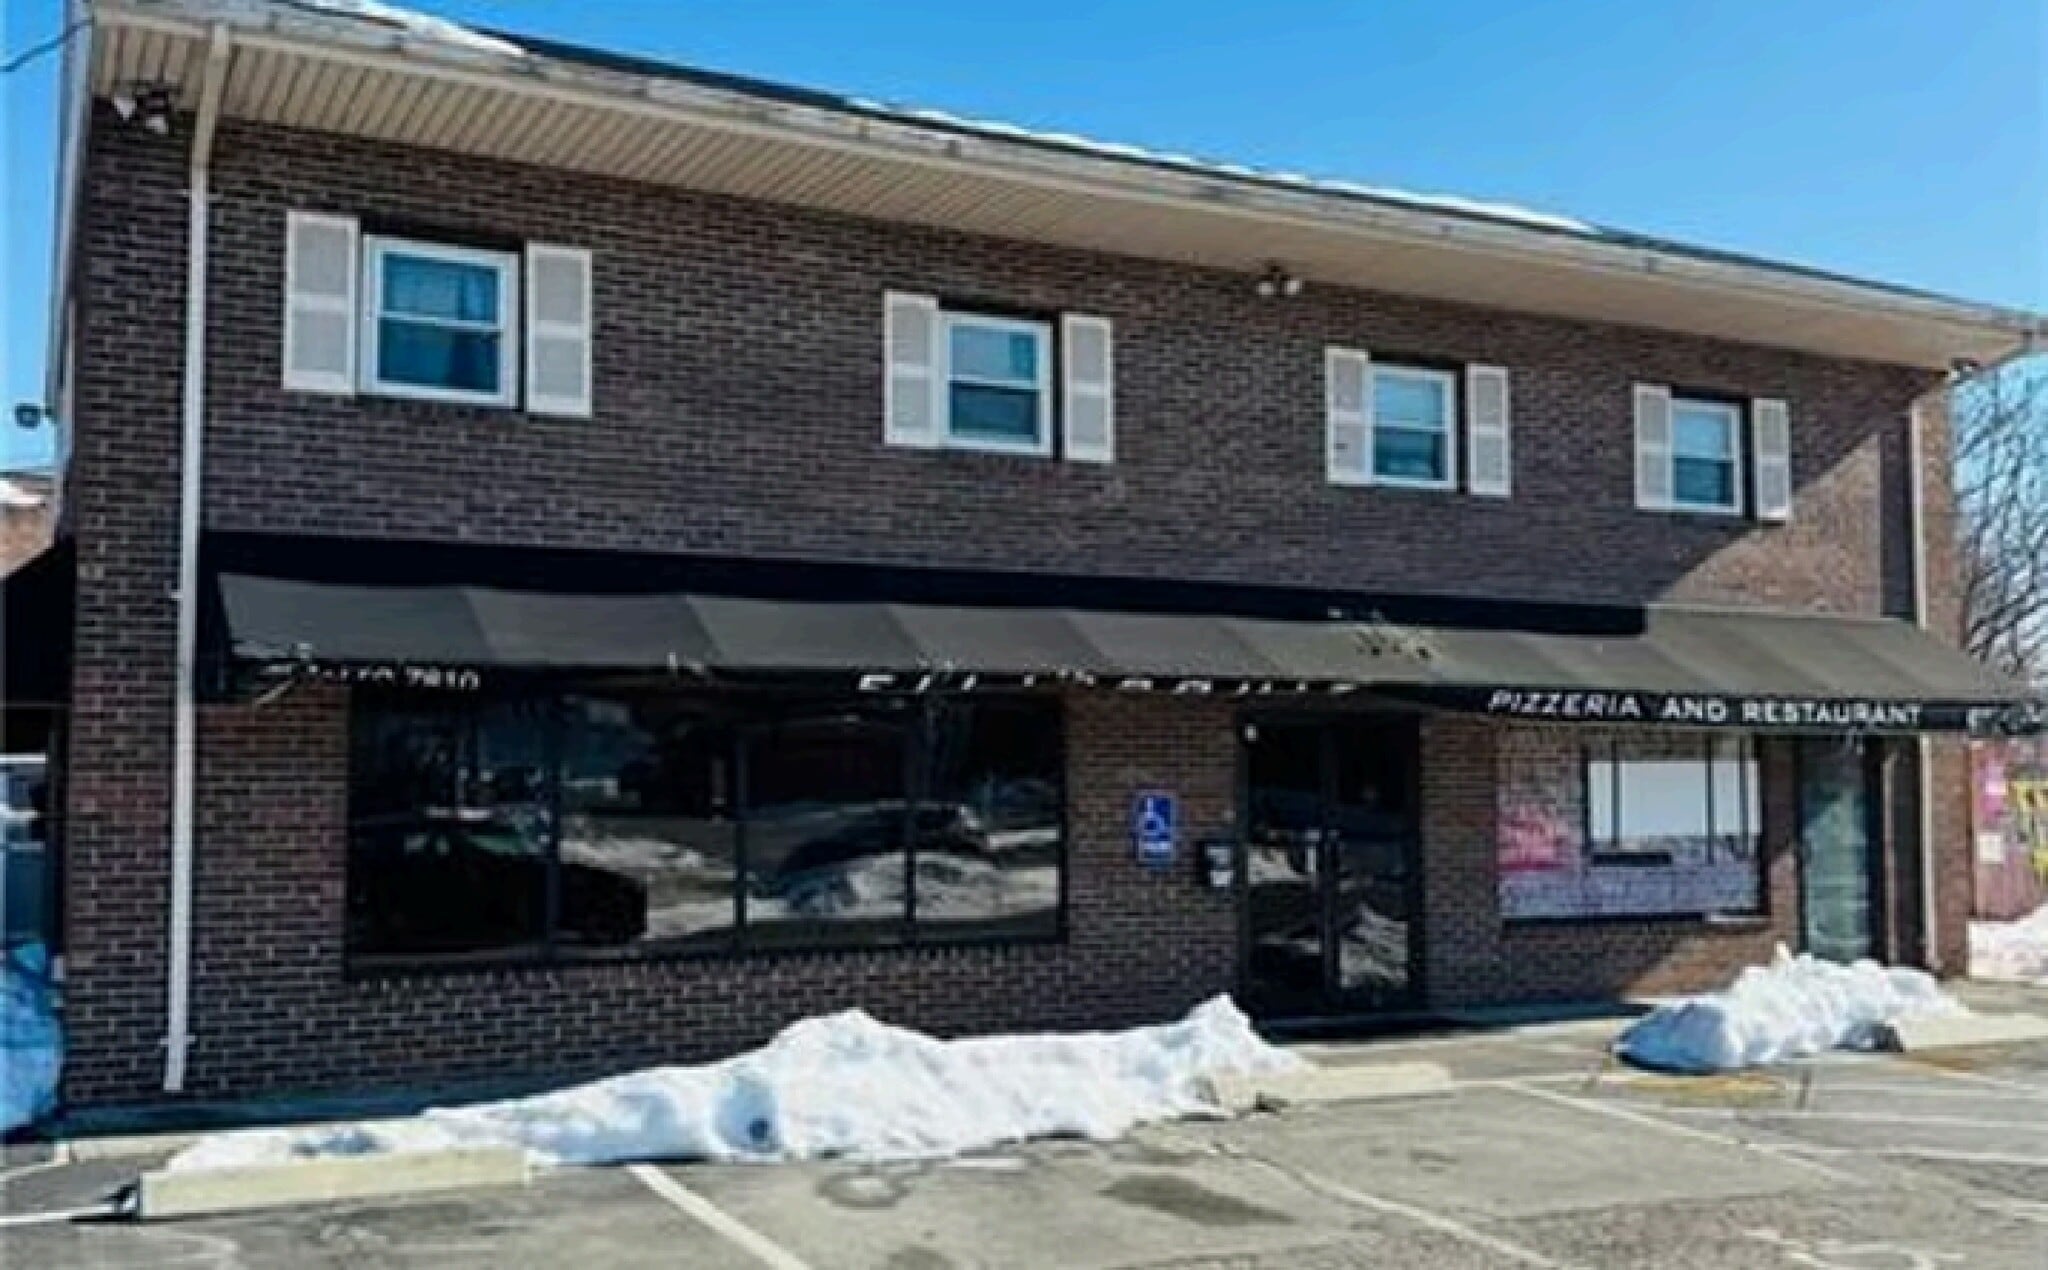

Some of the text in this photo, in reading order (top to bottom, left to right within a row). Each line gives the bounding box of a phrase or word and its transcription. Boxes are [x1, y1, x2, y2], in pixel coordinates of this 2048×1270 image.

[1488, 689, 1921, 724] PIZZERIA AND RESTAURANT
